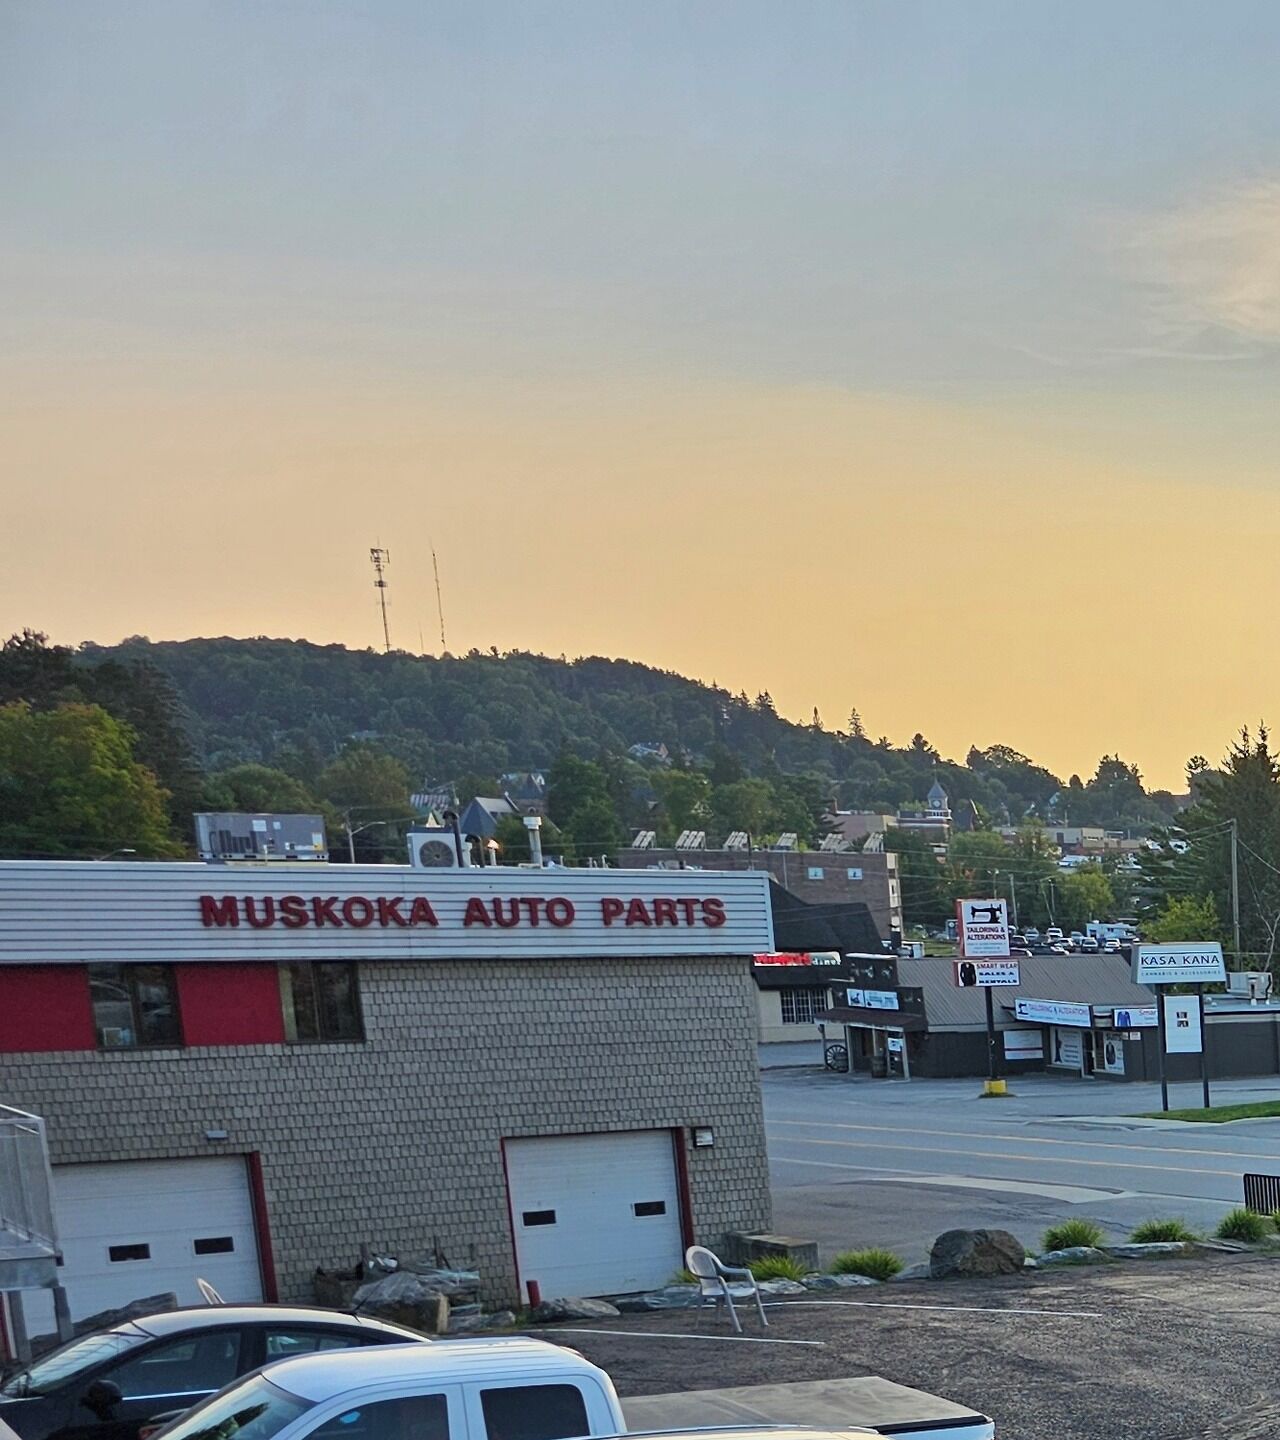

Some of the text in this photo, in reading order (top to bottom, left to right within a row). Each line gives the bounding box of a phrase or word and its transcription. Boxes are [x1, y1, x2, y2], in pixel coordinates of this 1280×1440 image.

[199, 895, 727, 928] MUSKOKA AUTO PARTS
[1141, 955, 1220, 965] KASA KANA
